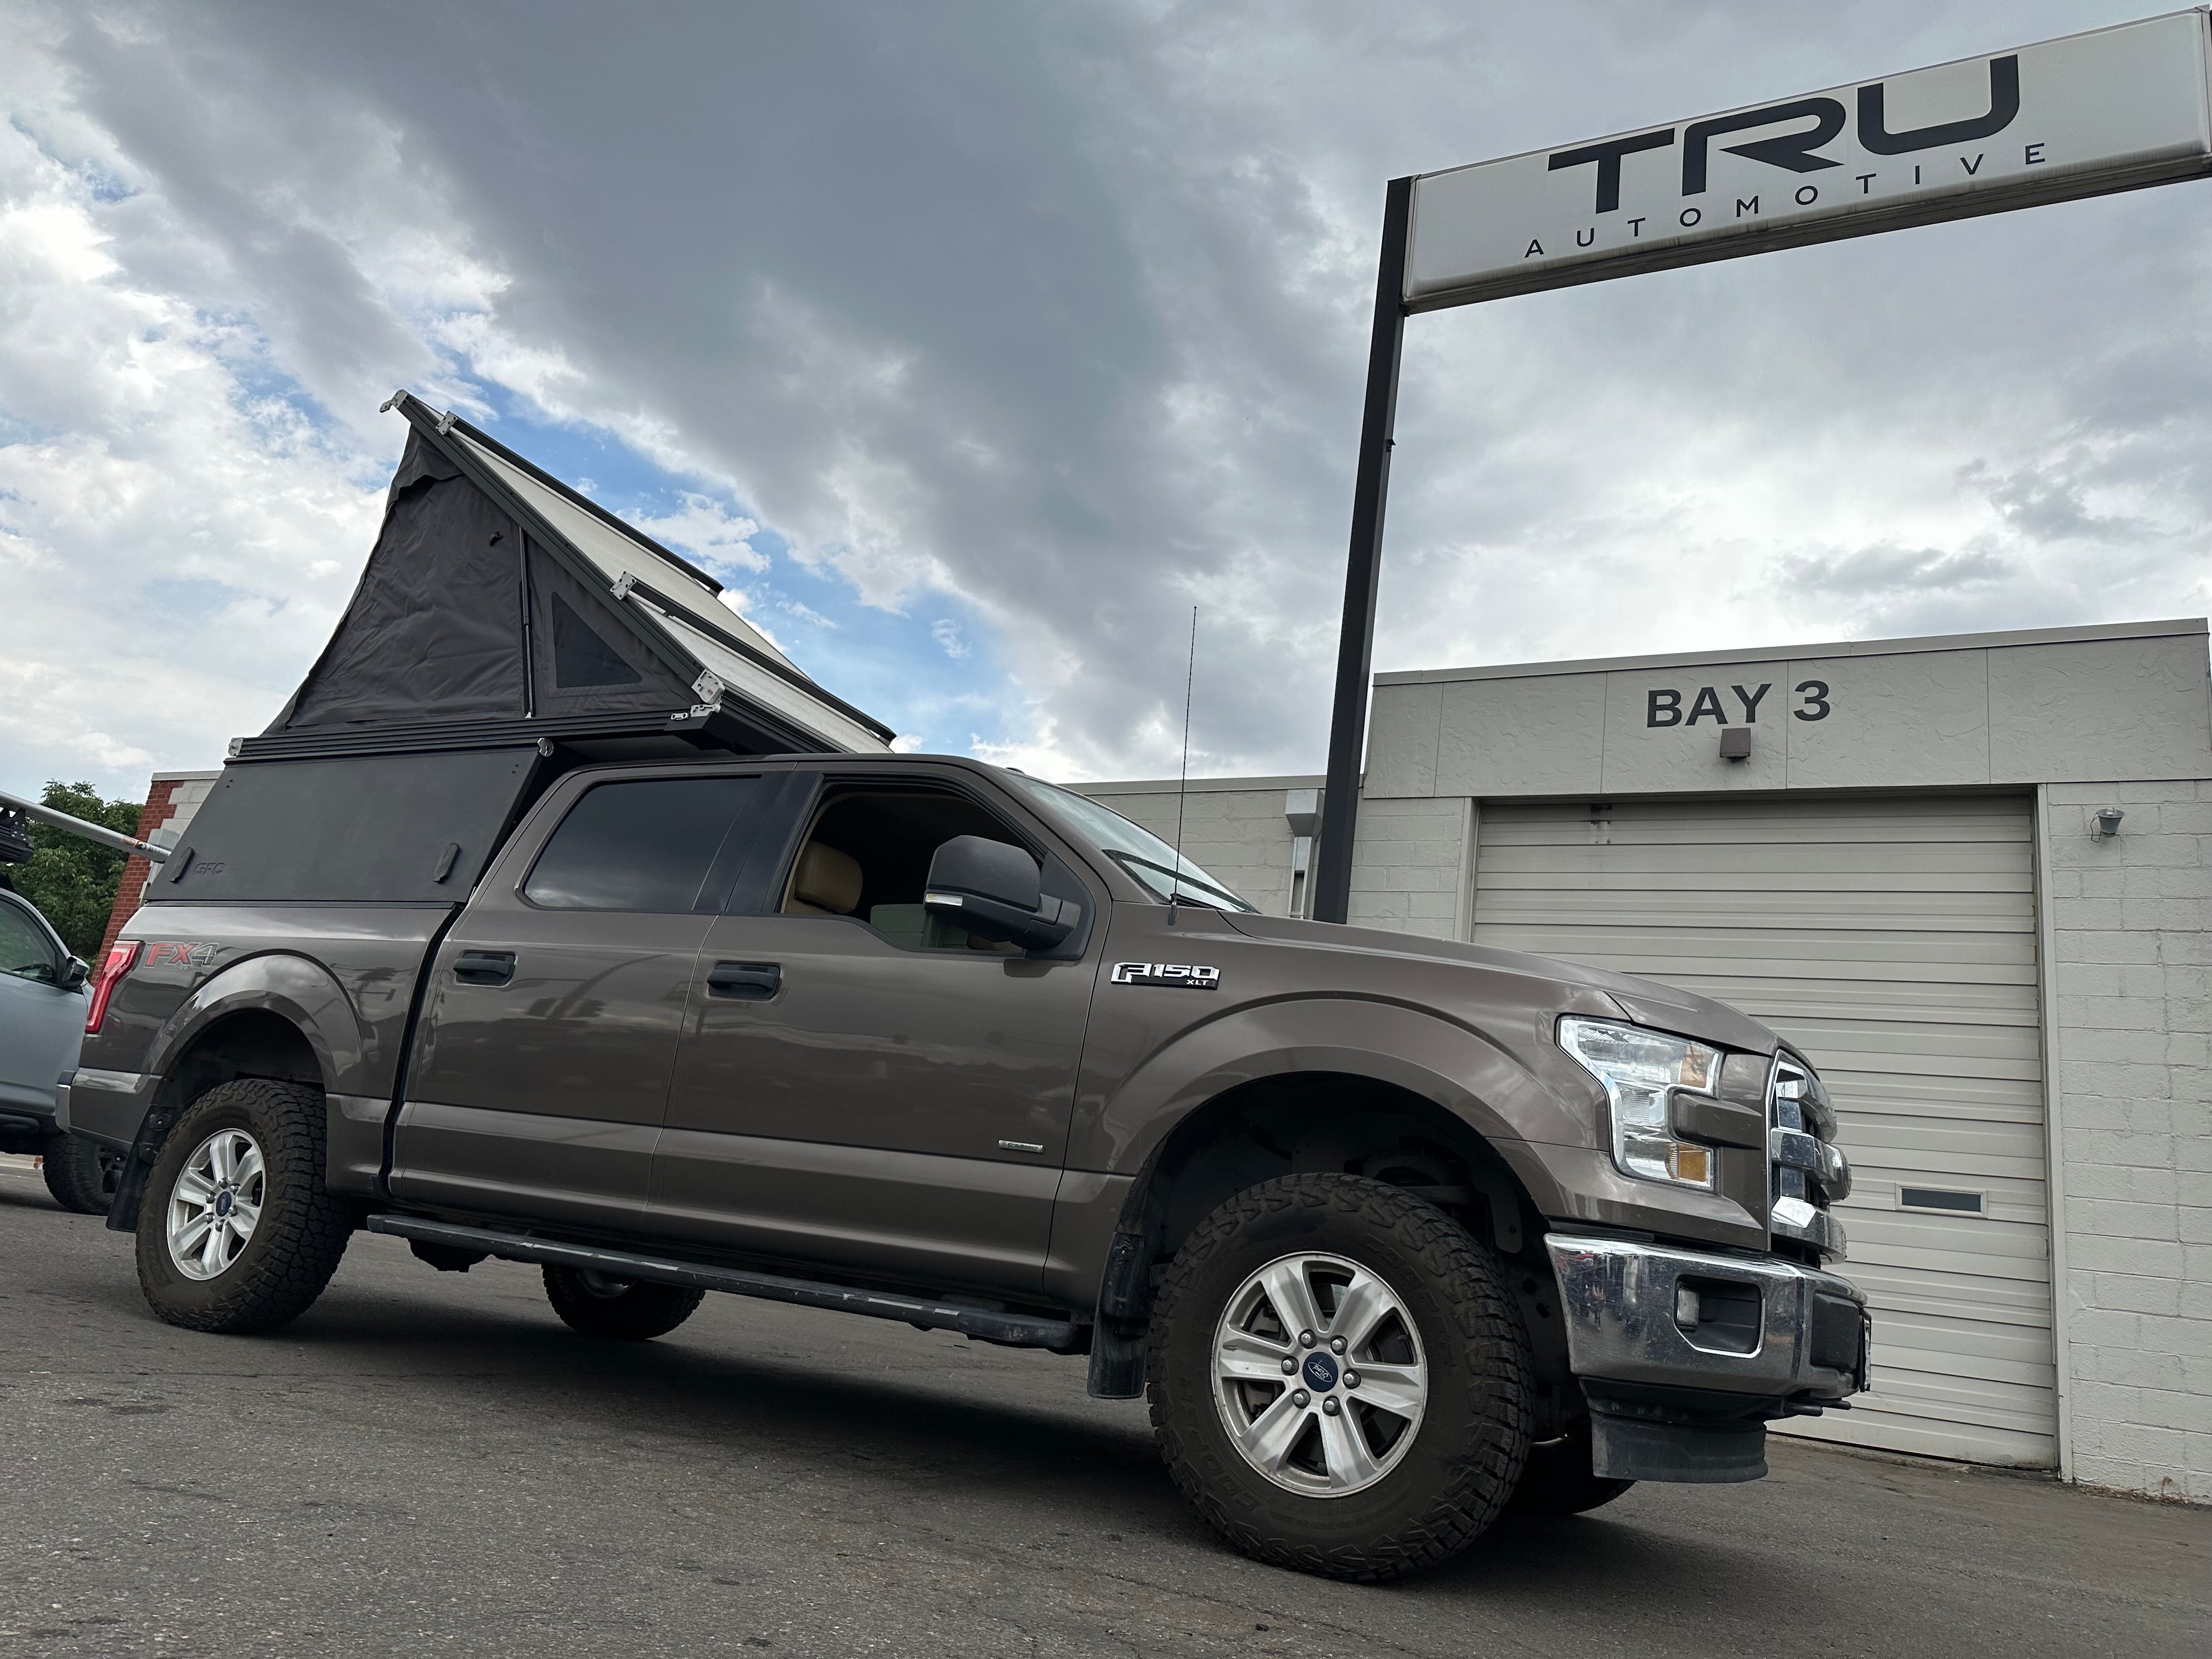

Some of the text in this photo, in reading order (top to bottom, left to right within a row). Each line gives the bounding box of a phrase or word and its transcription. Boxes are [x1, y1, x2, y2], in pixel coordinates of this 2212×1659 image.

[1548, 54, 2019, 214] TRU
[1525, 143, 2045, 258] AUTOMOTIVE
[1647, 680, 1830, 727] BAY 3
[193, 862, 225, 875] GFC
[144, 941, 219, 968] FX4
[1312, 1364, 1329, 1379] Ford
